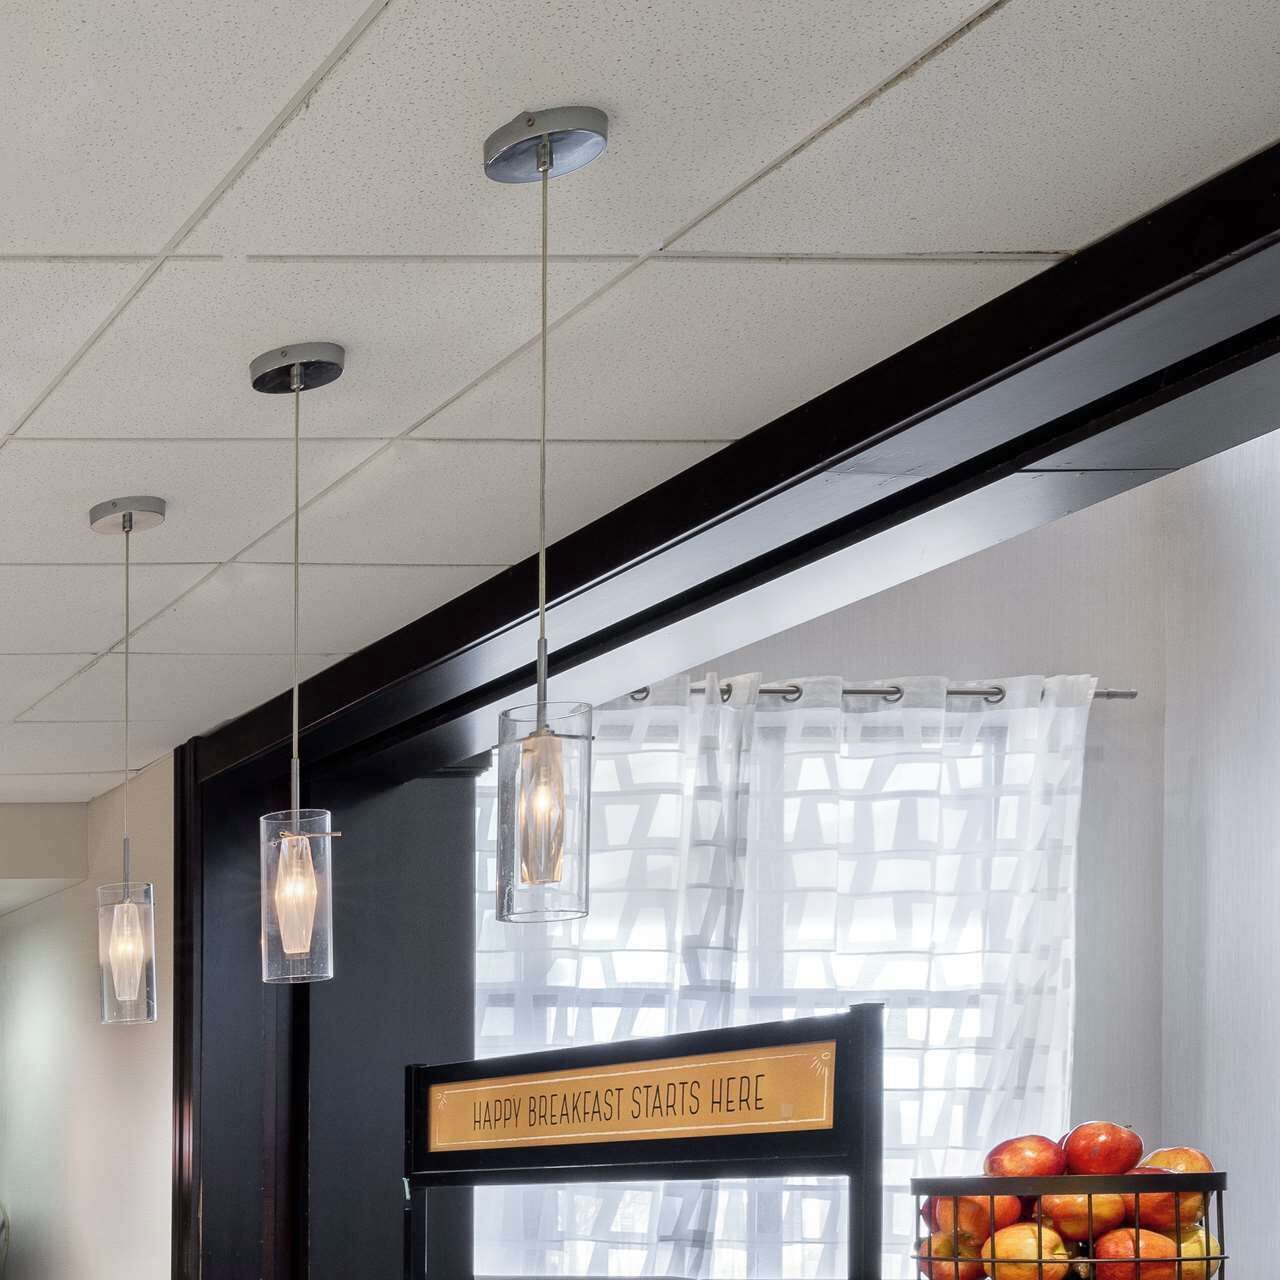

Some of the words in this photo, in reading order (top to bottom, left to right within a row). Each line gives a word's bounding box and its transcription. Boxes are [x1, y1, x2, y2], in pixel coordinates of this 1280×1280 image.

[473, 1097, 521, 1131] HAPPY
[528, 1088, 624, 1127] BREAKFAST
[631, 1080, 701, 1119] STARTS
[710, 1074, 766, 1114] HERE
